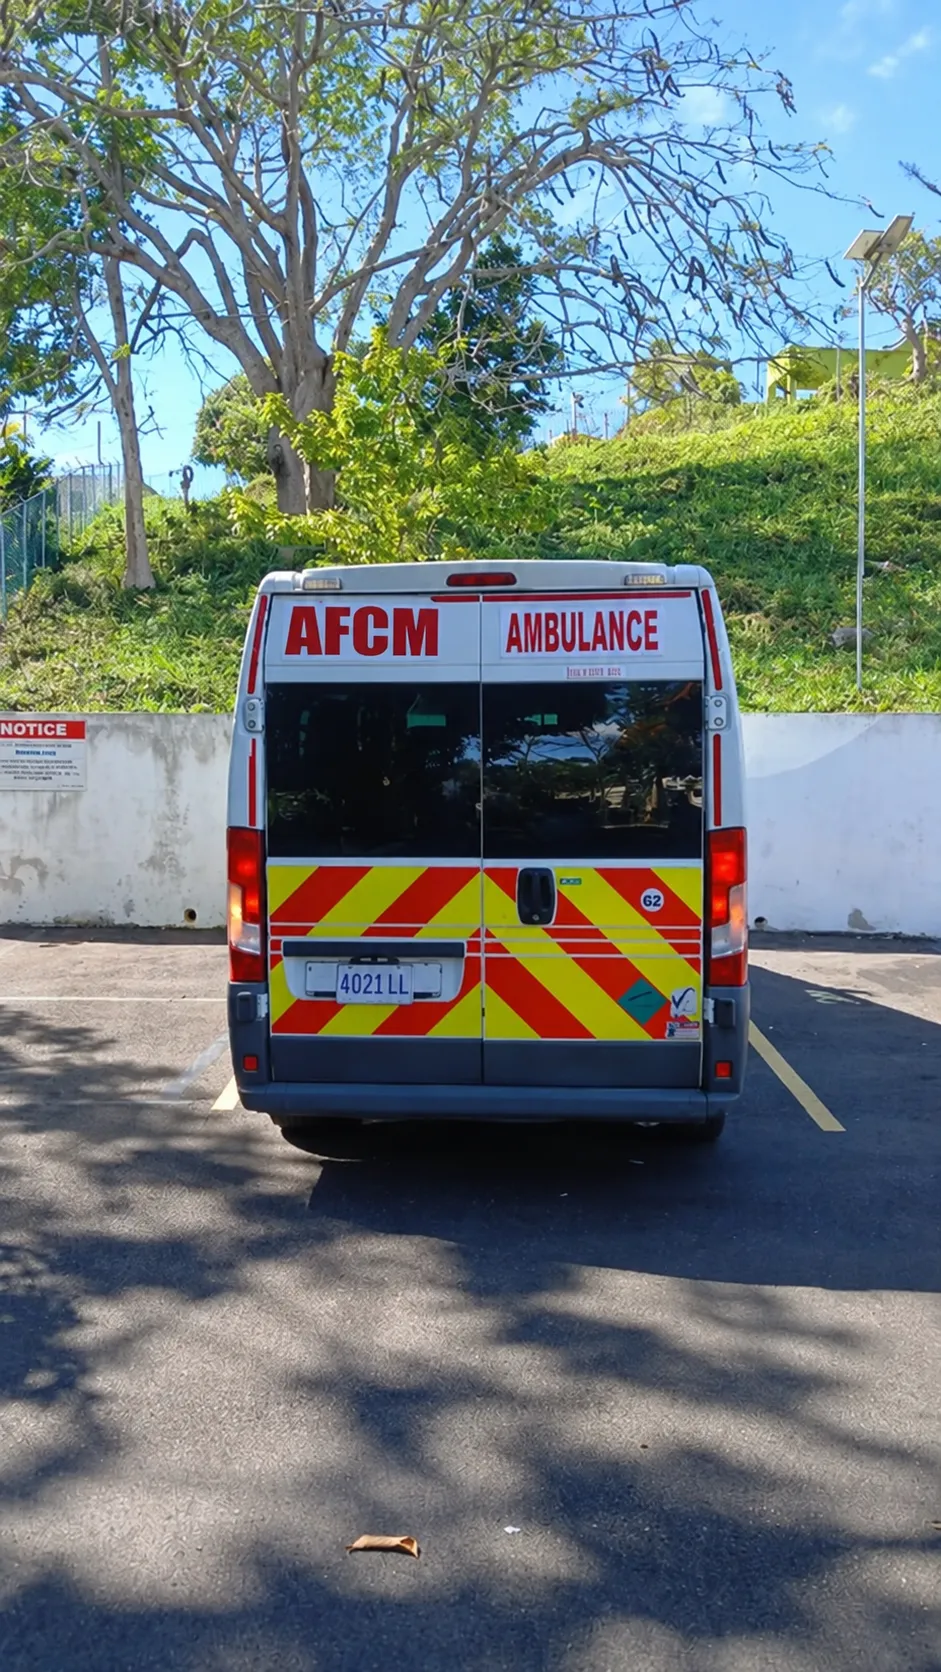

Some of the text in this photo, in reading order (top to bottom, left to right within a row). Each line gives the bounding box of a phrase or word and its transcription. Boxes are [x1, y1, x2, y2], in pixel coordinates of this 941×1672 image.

[285, 606, 439, 656] AFCM
[505, 610, 659, 653] AMBULANCE
[0, 723, 67, 736] NOTICE
[642, 895, 662, 907] 62
[340, 973, 409, 994] 4021 LL
